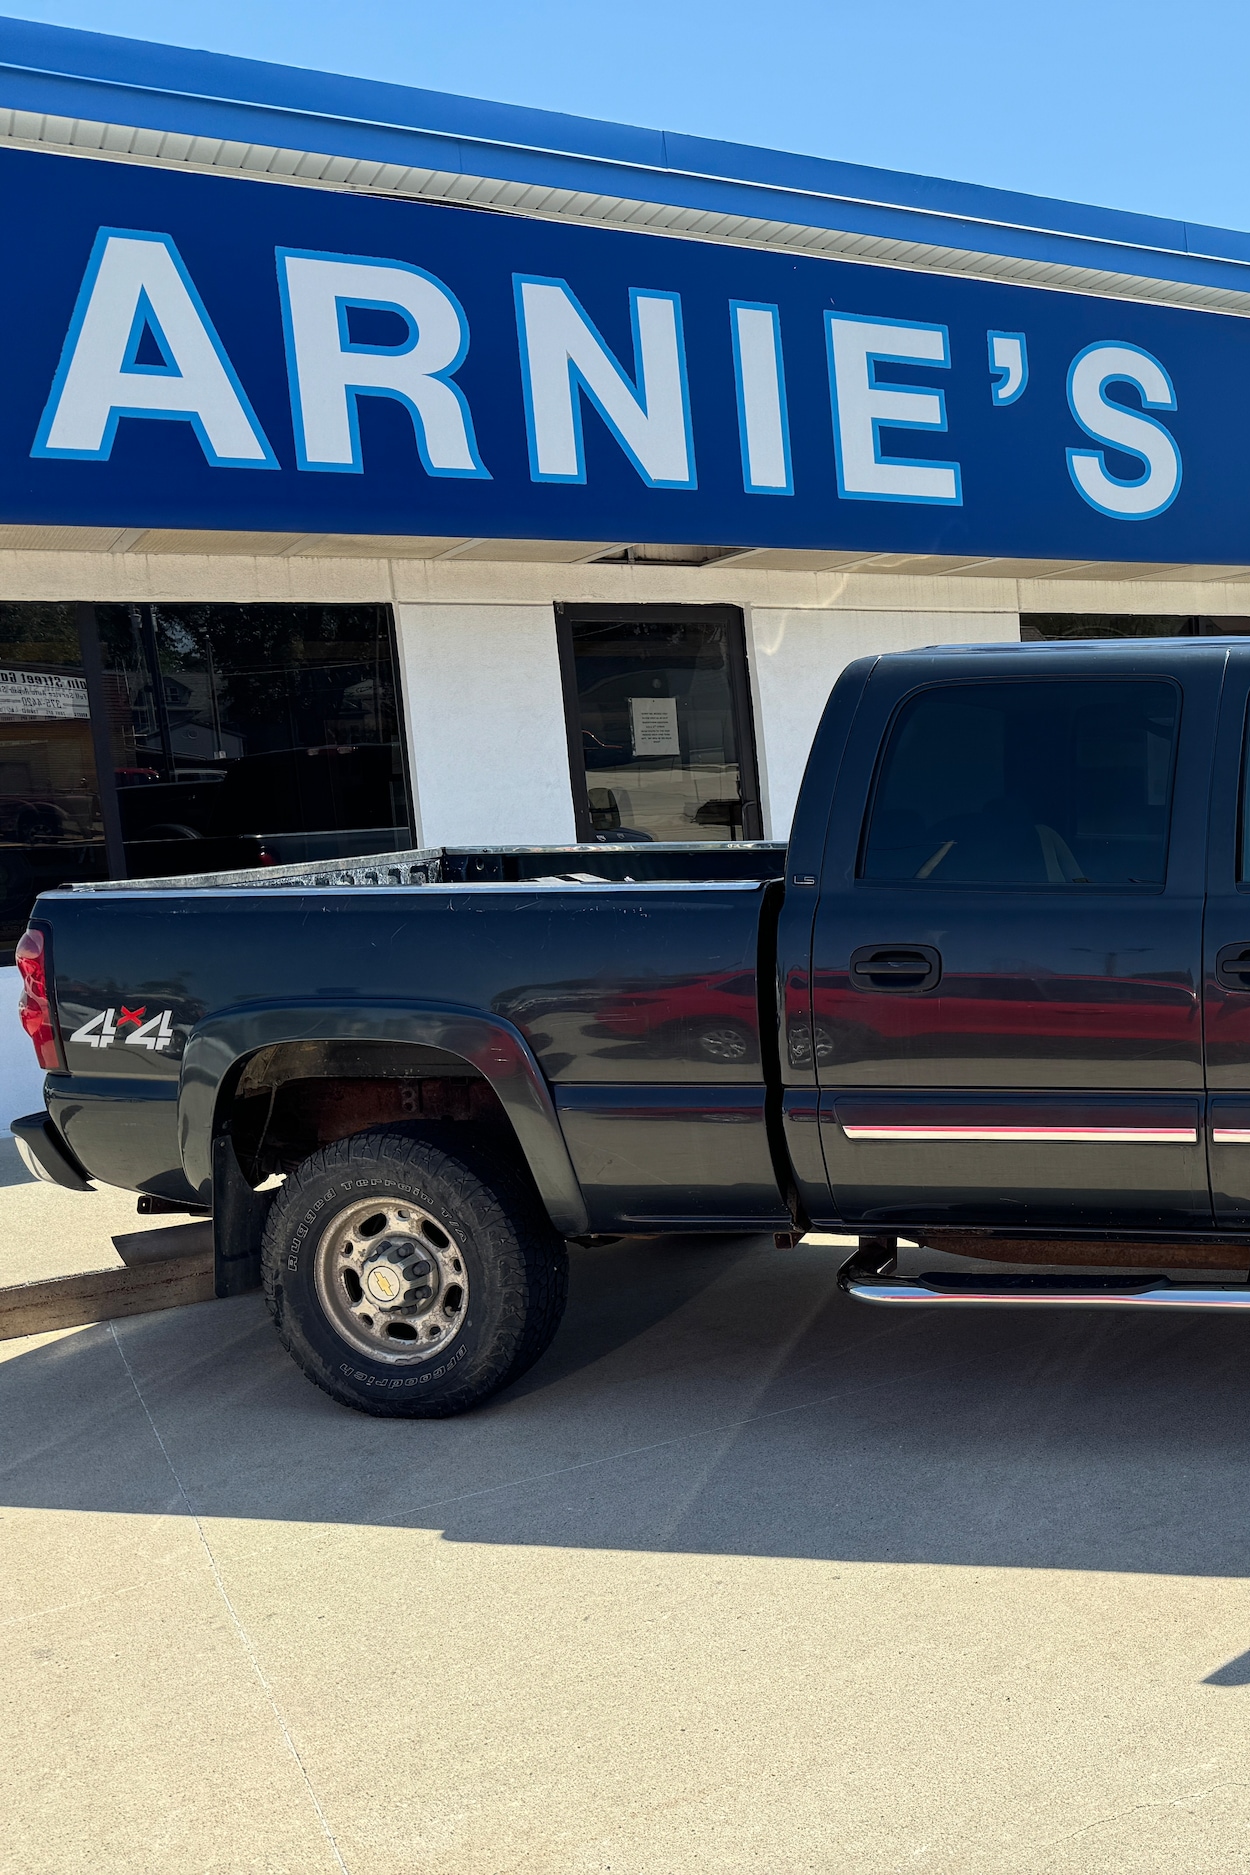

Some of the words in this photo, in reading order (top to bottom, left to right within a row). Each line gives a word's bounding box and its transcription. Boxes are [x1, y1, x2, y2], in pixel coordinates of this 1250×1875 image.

[29, 226, 1183, 520] ARNIE'S
[793, 875, 815, 885] LS
[287, 1188, 337, 1273] Rugged
[340, 1177, 436, 1206] Terrain
[440, 1206, 469, 1244] T/A
[339, 1343, 469, 1390] BFGoodrich
